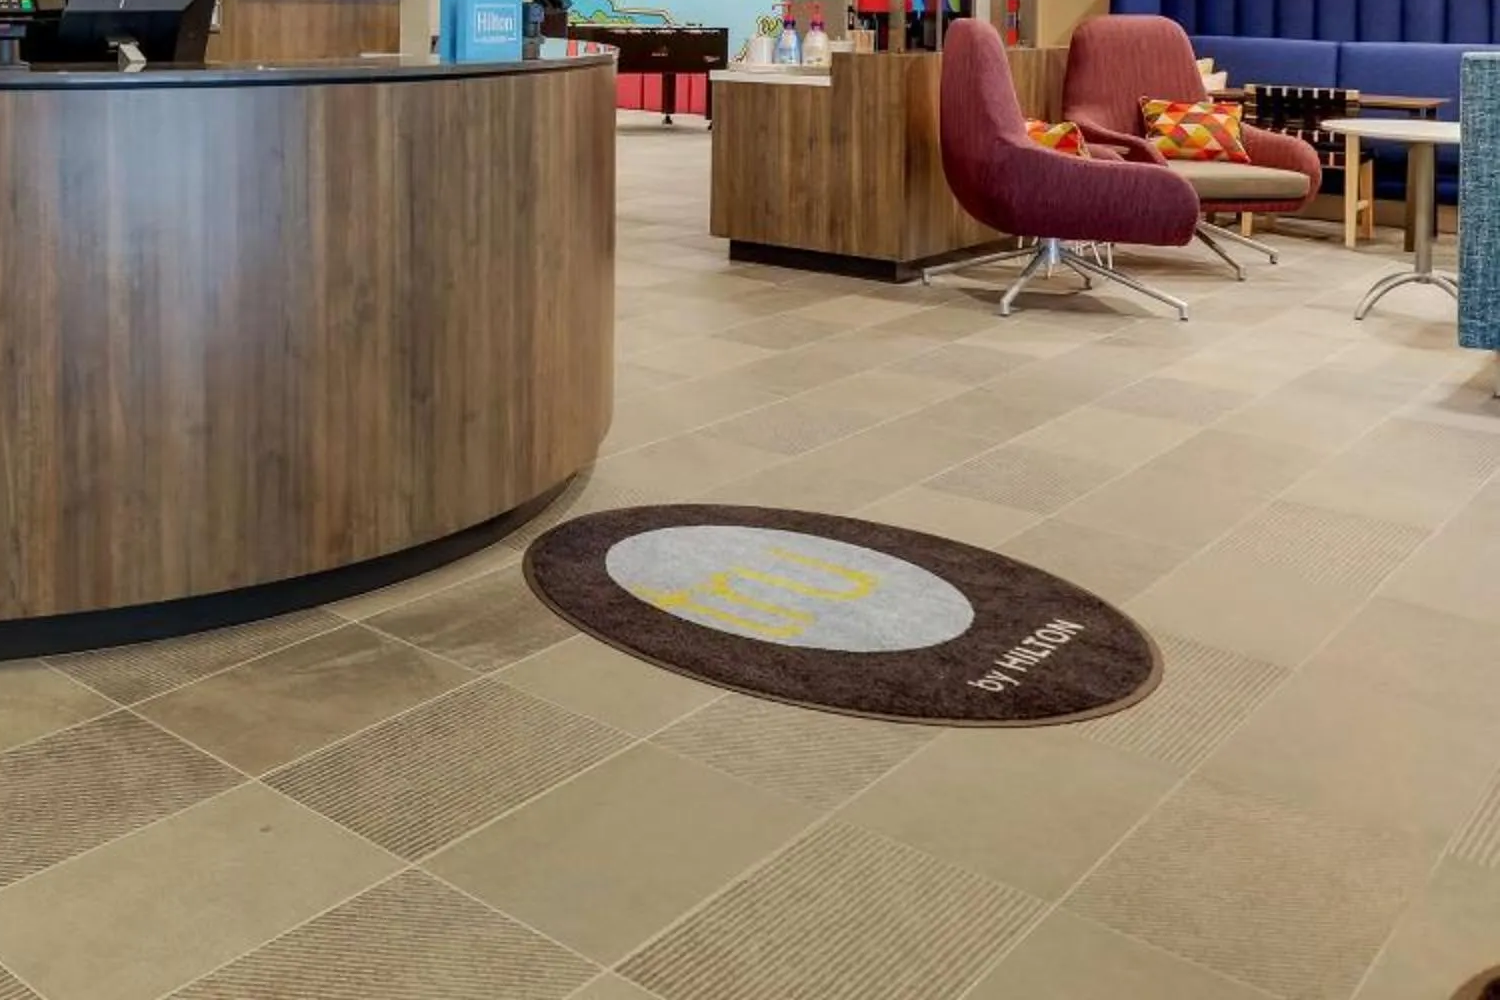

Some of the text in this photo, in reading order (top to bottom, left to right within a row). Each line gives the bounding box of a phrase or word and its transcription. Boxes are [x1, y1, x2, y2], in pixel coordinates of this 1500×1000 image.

[477, 11, 513, 34] Hilton
[967, 618, 1085, 692] by HILTON
